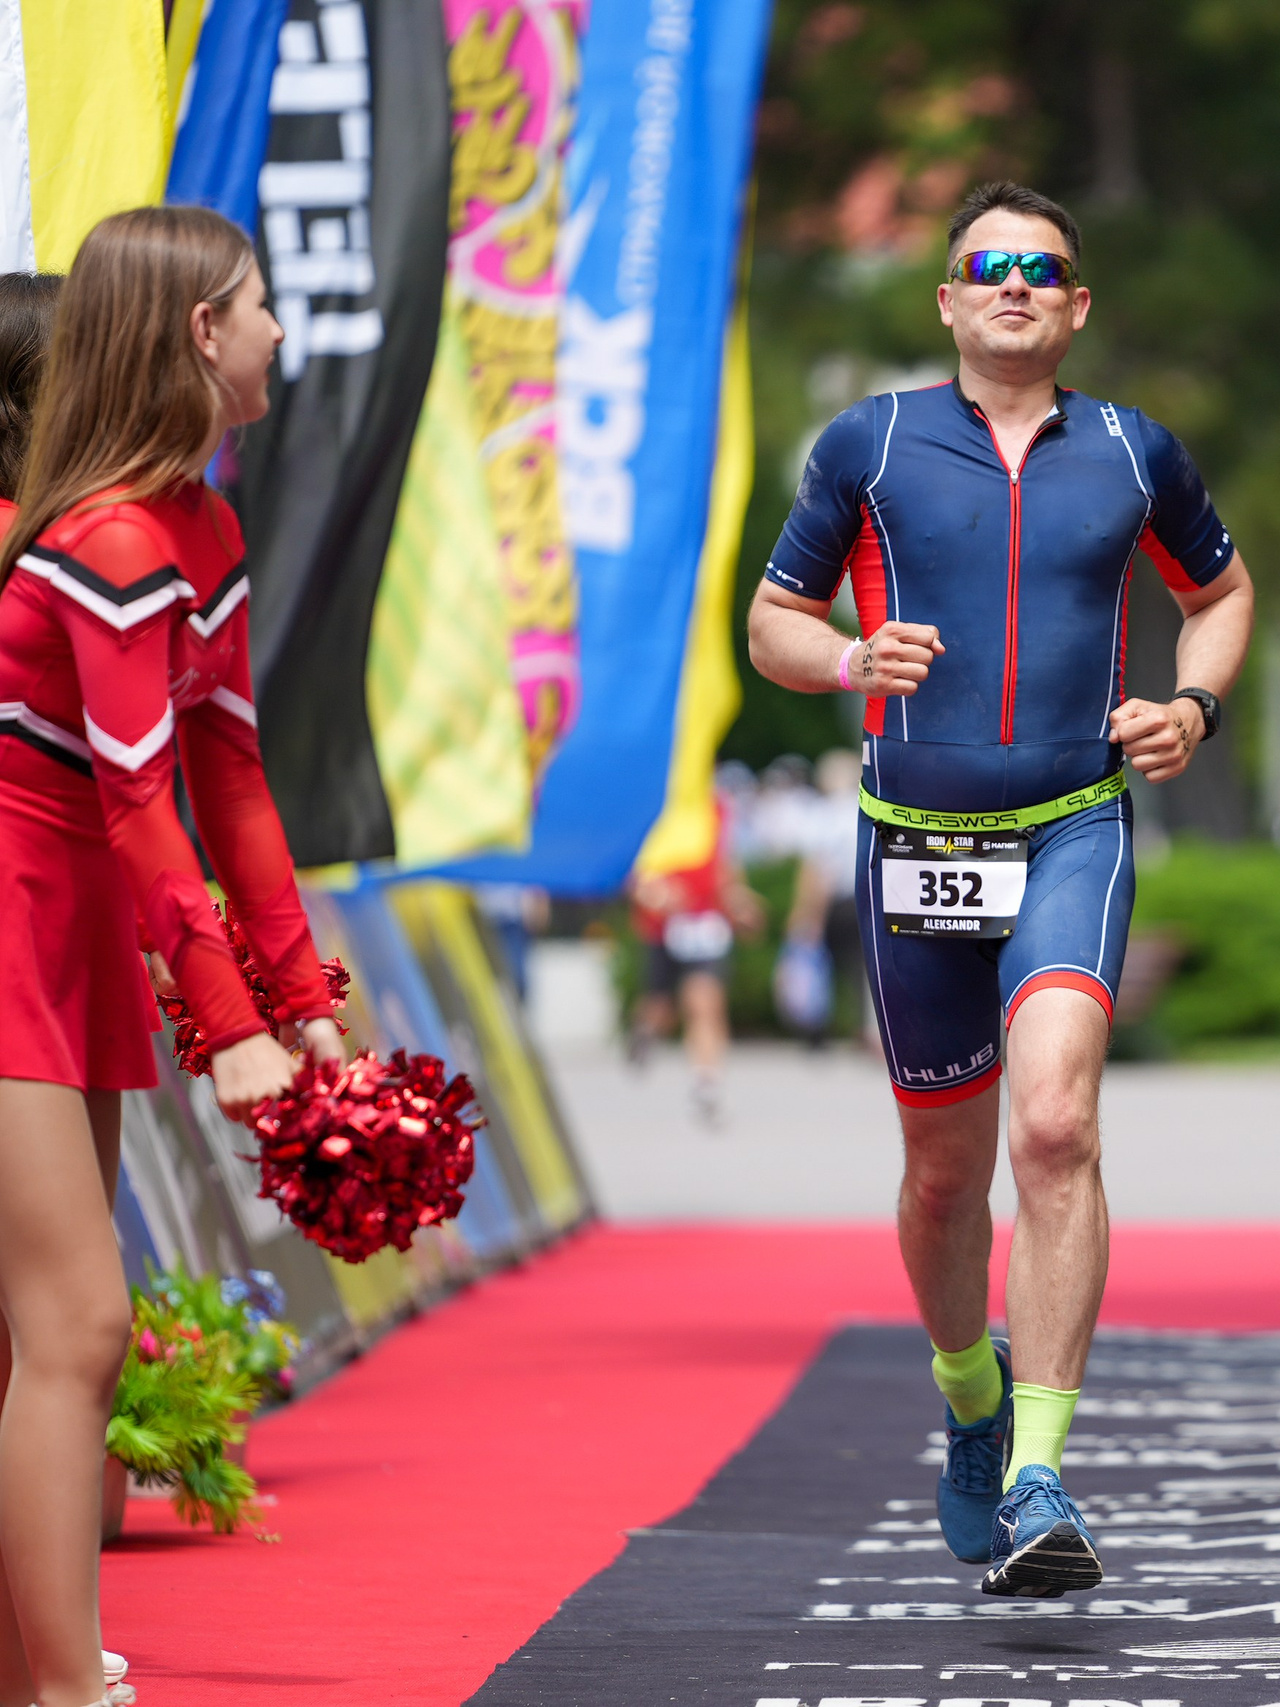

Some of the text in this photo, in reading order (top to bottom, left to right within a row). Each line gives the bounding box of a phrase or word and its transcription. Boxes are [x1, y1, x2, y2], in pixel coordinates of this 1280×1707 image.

[862, 640, 875, 678] 352
[926, 835, 974, 847] IRON STAR
[918, 870, 984, 907] 352
[923, 918, 980, 931] ALEKSANDR
[903, 1042, 993, 1082] HUUB
[812, 1598, 1190, 1617] IRON
